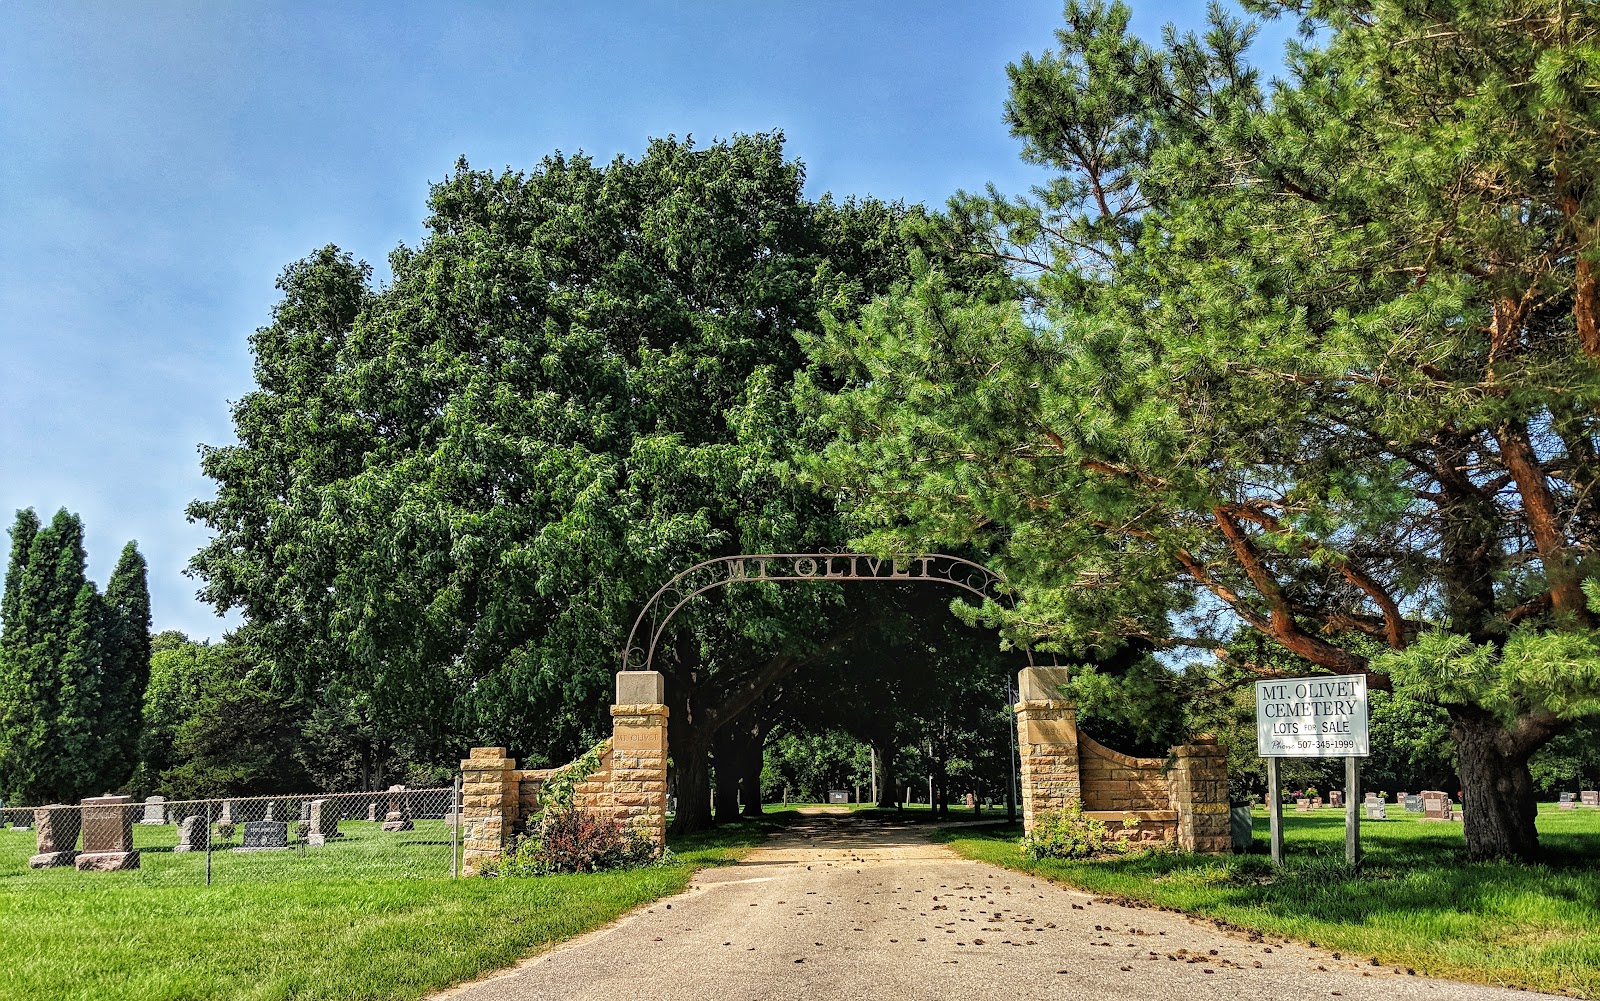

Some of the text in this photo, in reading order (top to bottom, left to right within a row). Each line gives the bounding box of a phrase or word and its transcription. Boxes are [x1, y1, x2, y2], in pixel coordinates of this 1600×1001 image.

[726, 557, 772, 578] MT
[1263, 681, 1359, 700] MT. OLIVET
[1265, 700, 1358, 718] CEMETERY
[1273, 722, 1299, 734] LOTS
[1322, 721, 1350, 733] SALE
[1271, 740, 1354, 750] Phone 507-345-1999
